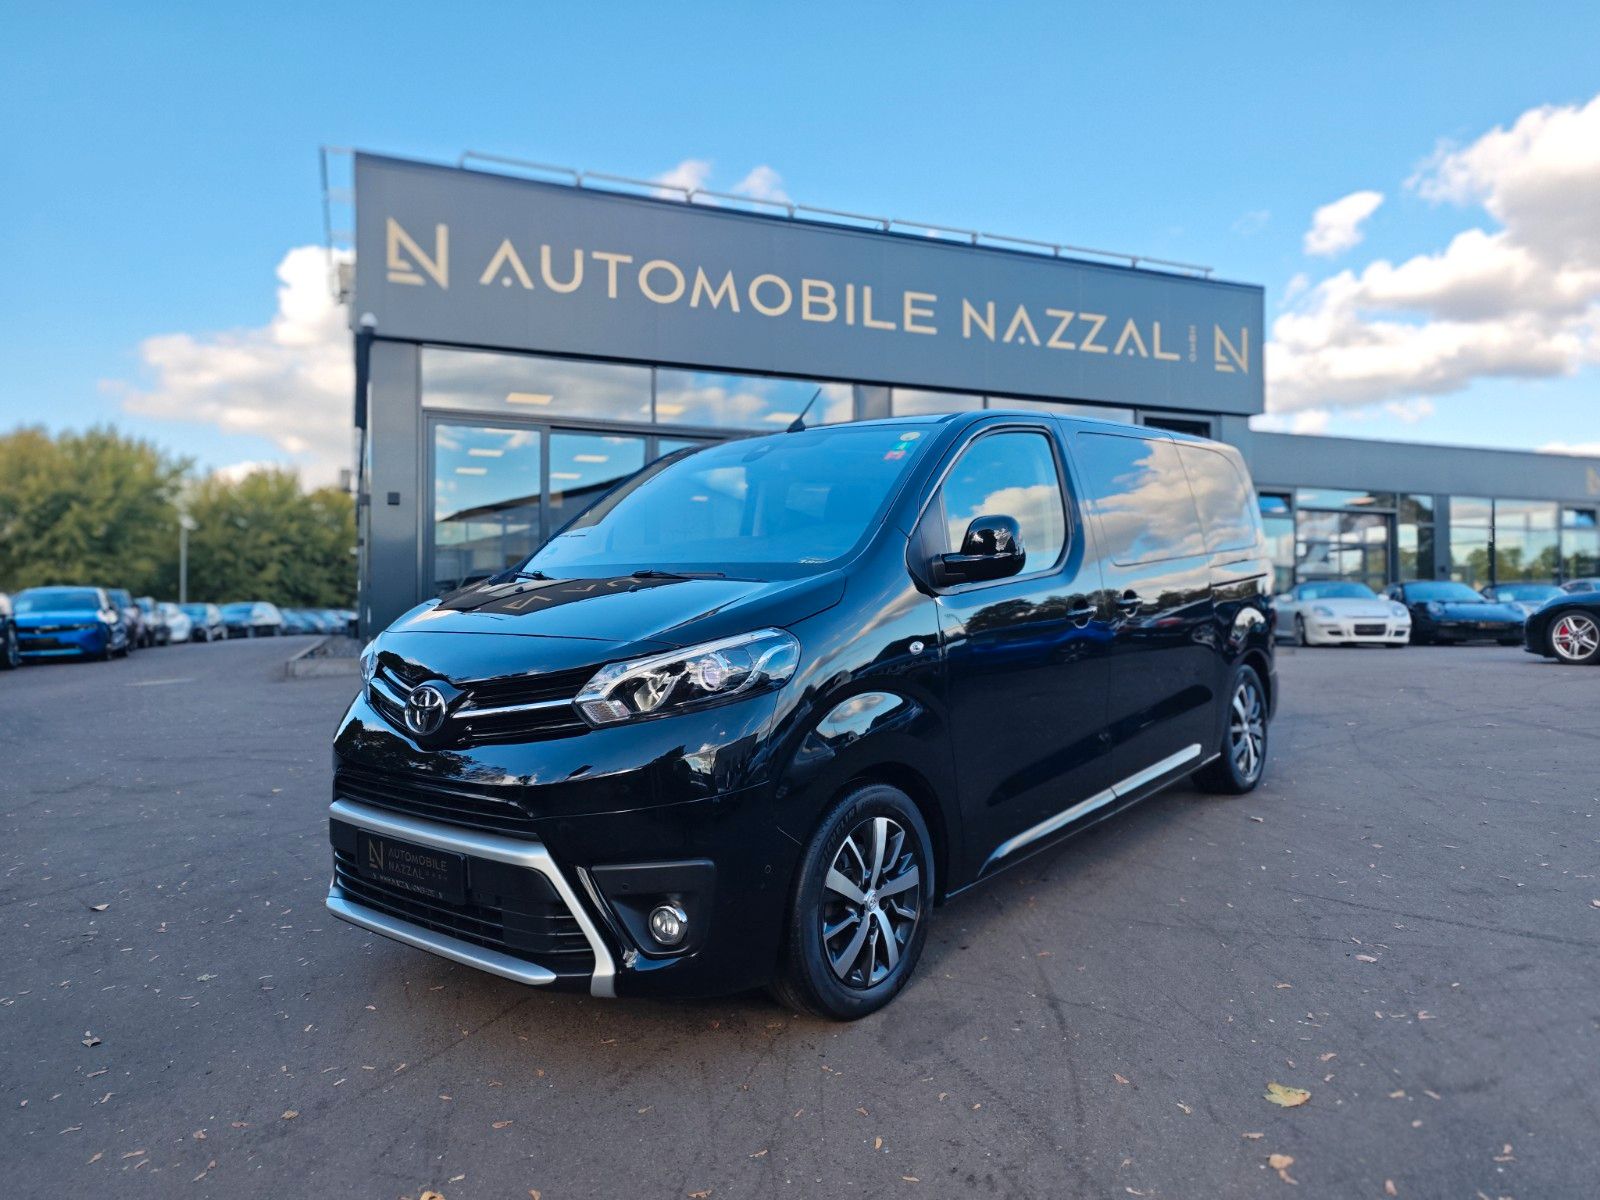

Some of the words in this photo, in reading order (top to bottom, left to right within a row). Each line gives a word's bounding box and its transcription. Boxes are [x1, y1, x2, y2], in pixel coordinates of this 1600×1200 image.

[479, 238, 938, 336] AUTOMOBILE
[962, 298, 1182, 362] NAZZAL
[388, 847, 448, 872] AUTOMOBILE
[388, 860, 425, 880] NAZZAL
